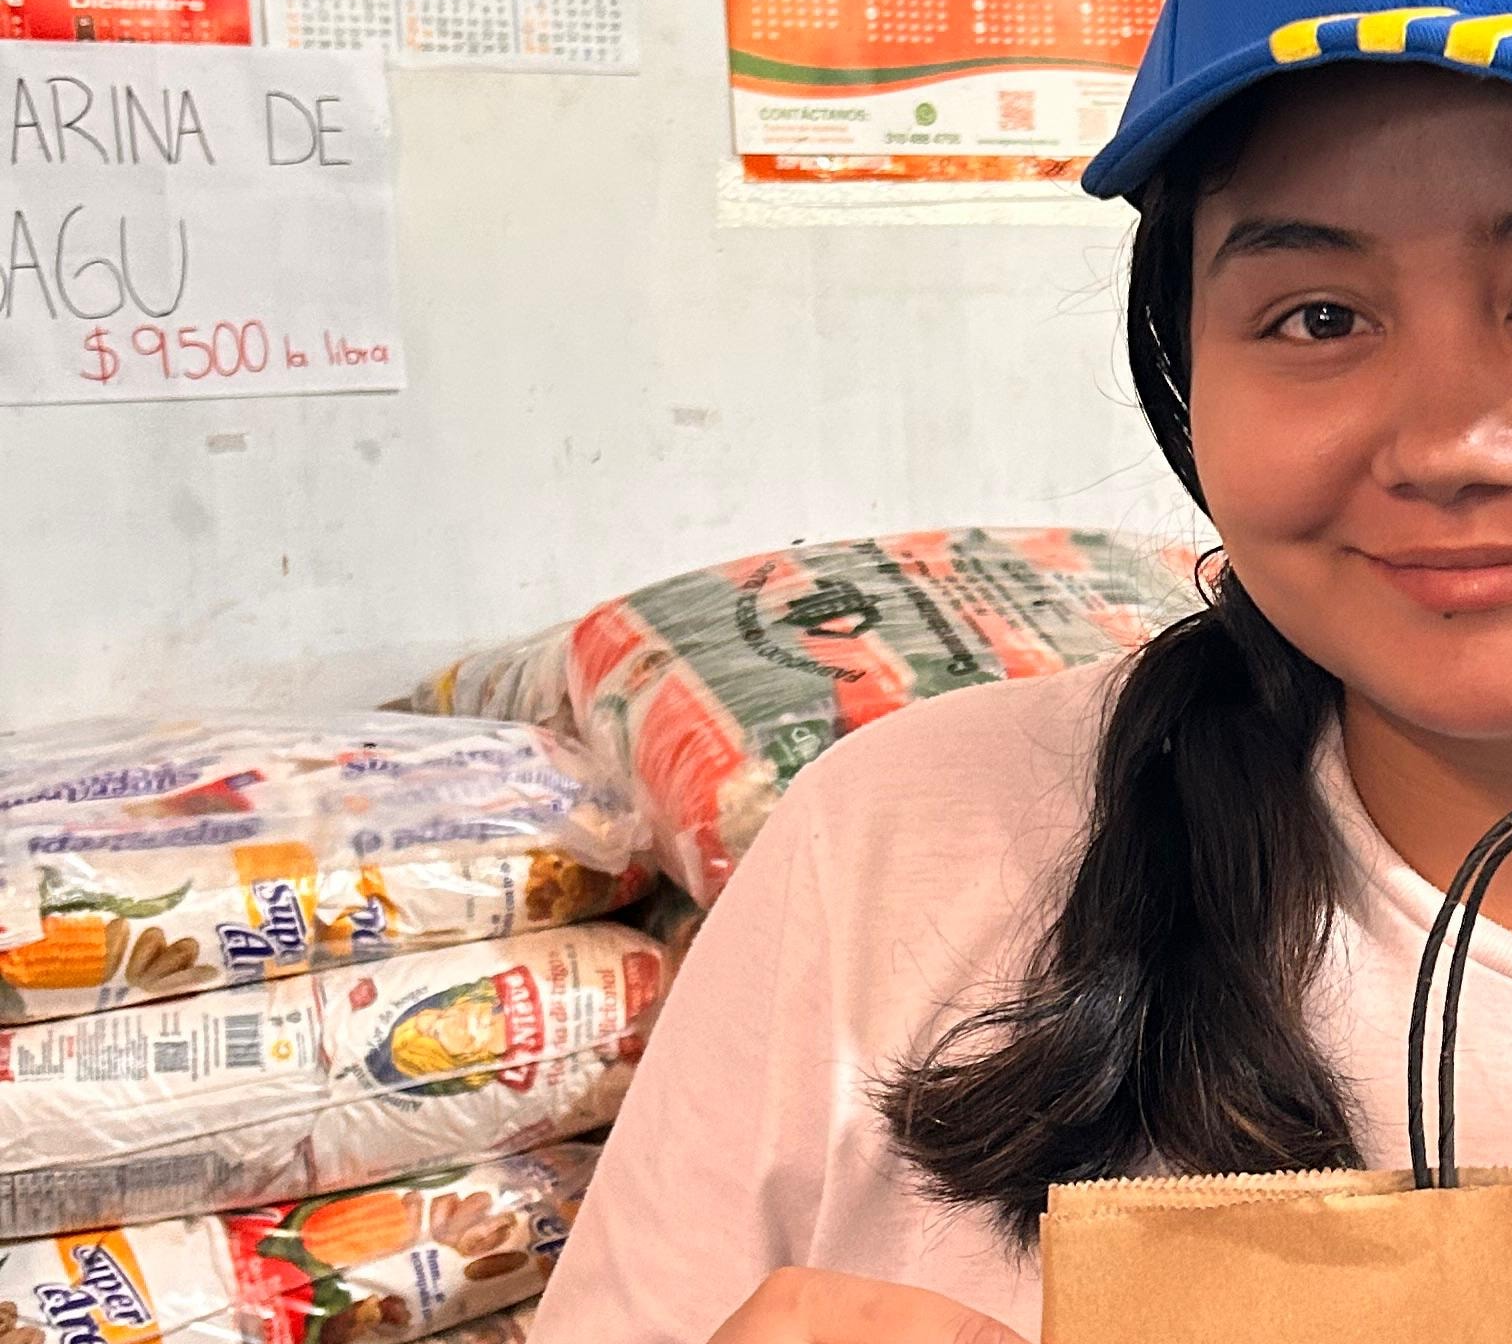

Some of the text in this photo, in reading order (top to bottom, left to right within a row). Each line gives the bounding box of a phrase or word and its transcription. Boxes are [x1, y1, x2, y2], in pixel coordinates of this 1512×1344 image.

[265, 89, 352, 167] DE
[284, 333, 309, 368] la
[72, 1242, 152, 1327] Super
